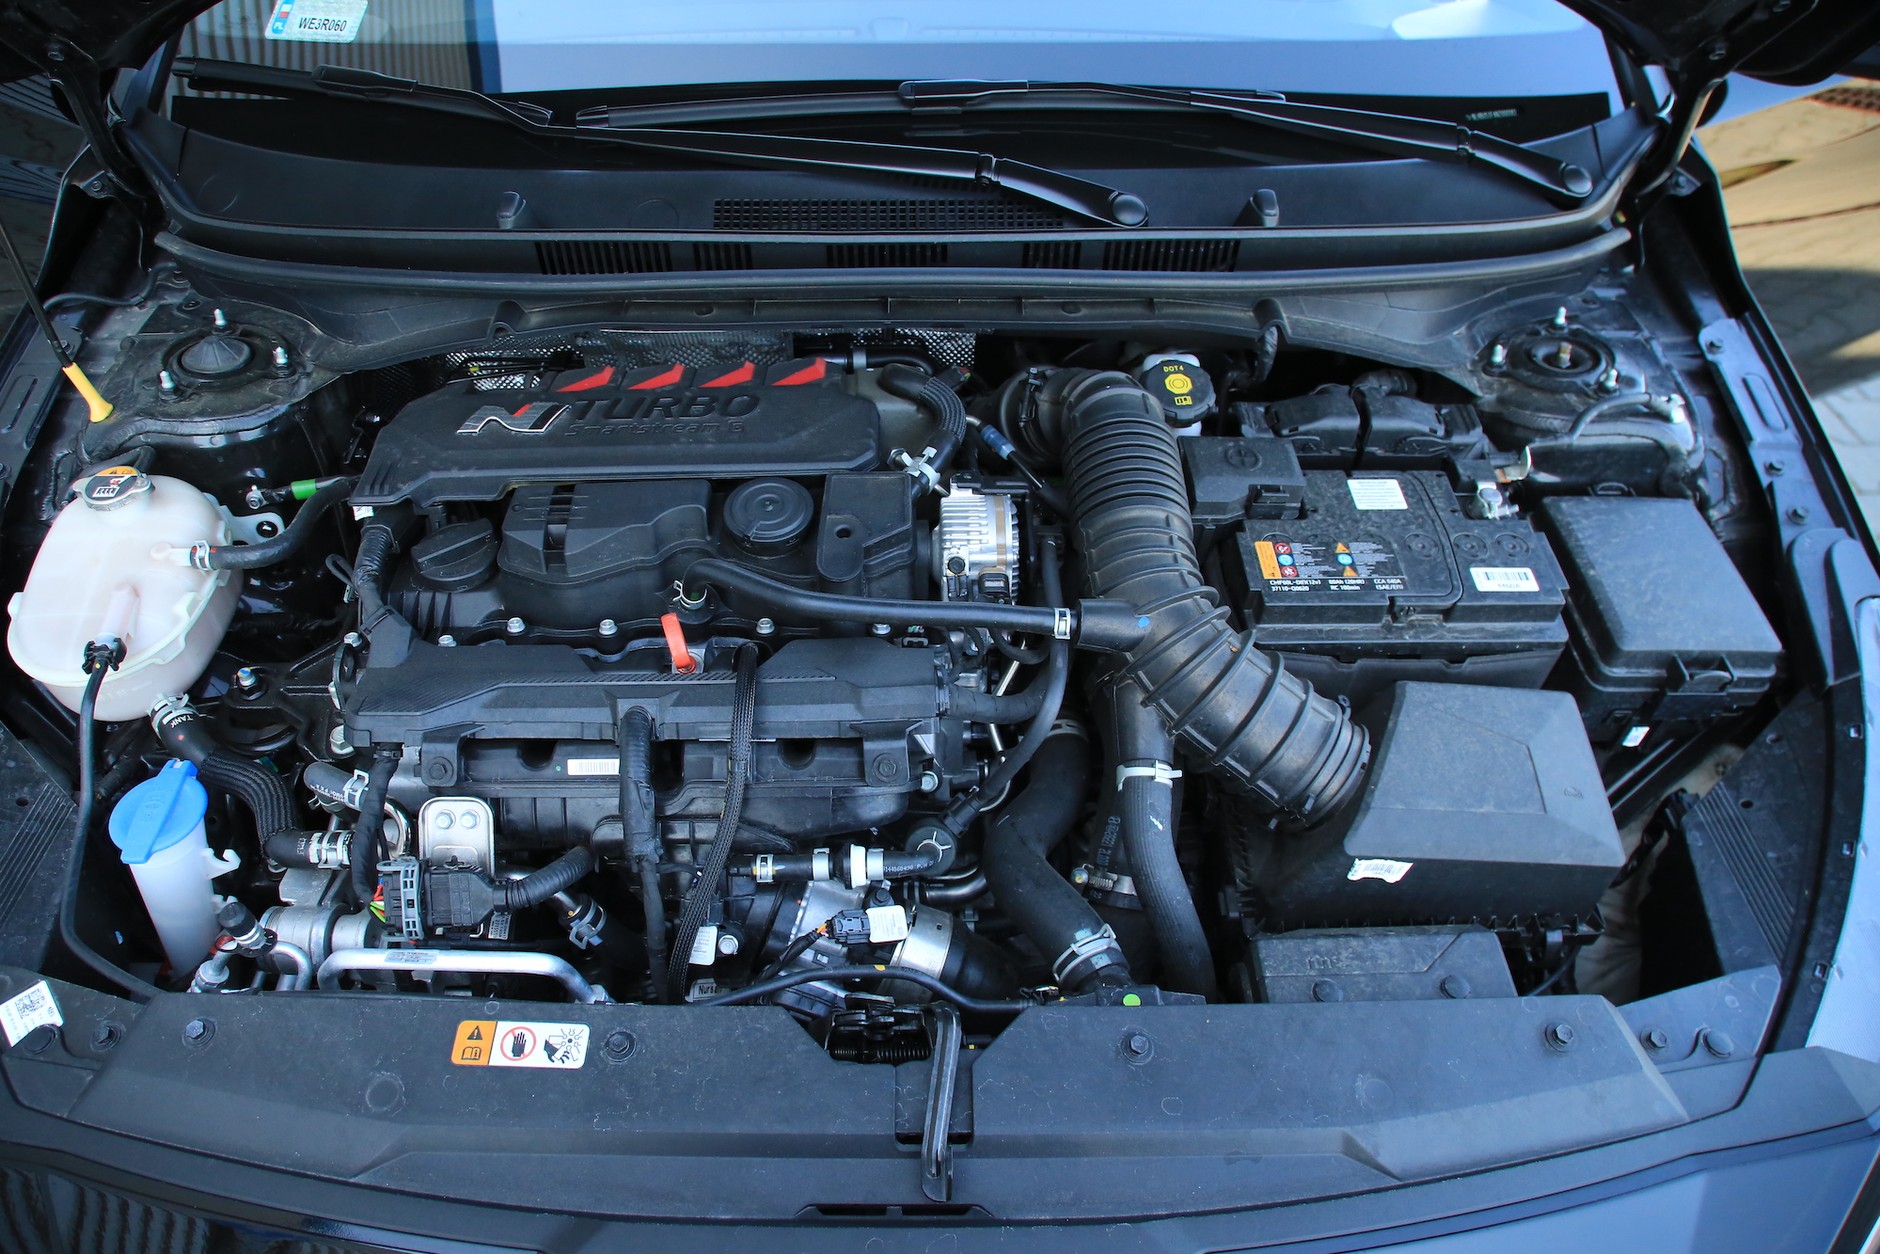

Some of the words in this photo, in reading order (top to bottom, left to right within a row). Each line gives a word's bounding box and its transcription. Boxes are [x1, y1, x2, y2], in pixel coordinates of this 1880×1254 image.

[273, 22, 284, 30] PL
[298, 17, 347, 32] WE3R060
[575, 395, 760, 421] TURBO
[564, 420, 720, 438] Smartstream
[170, 715, 193, 728] TANK
